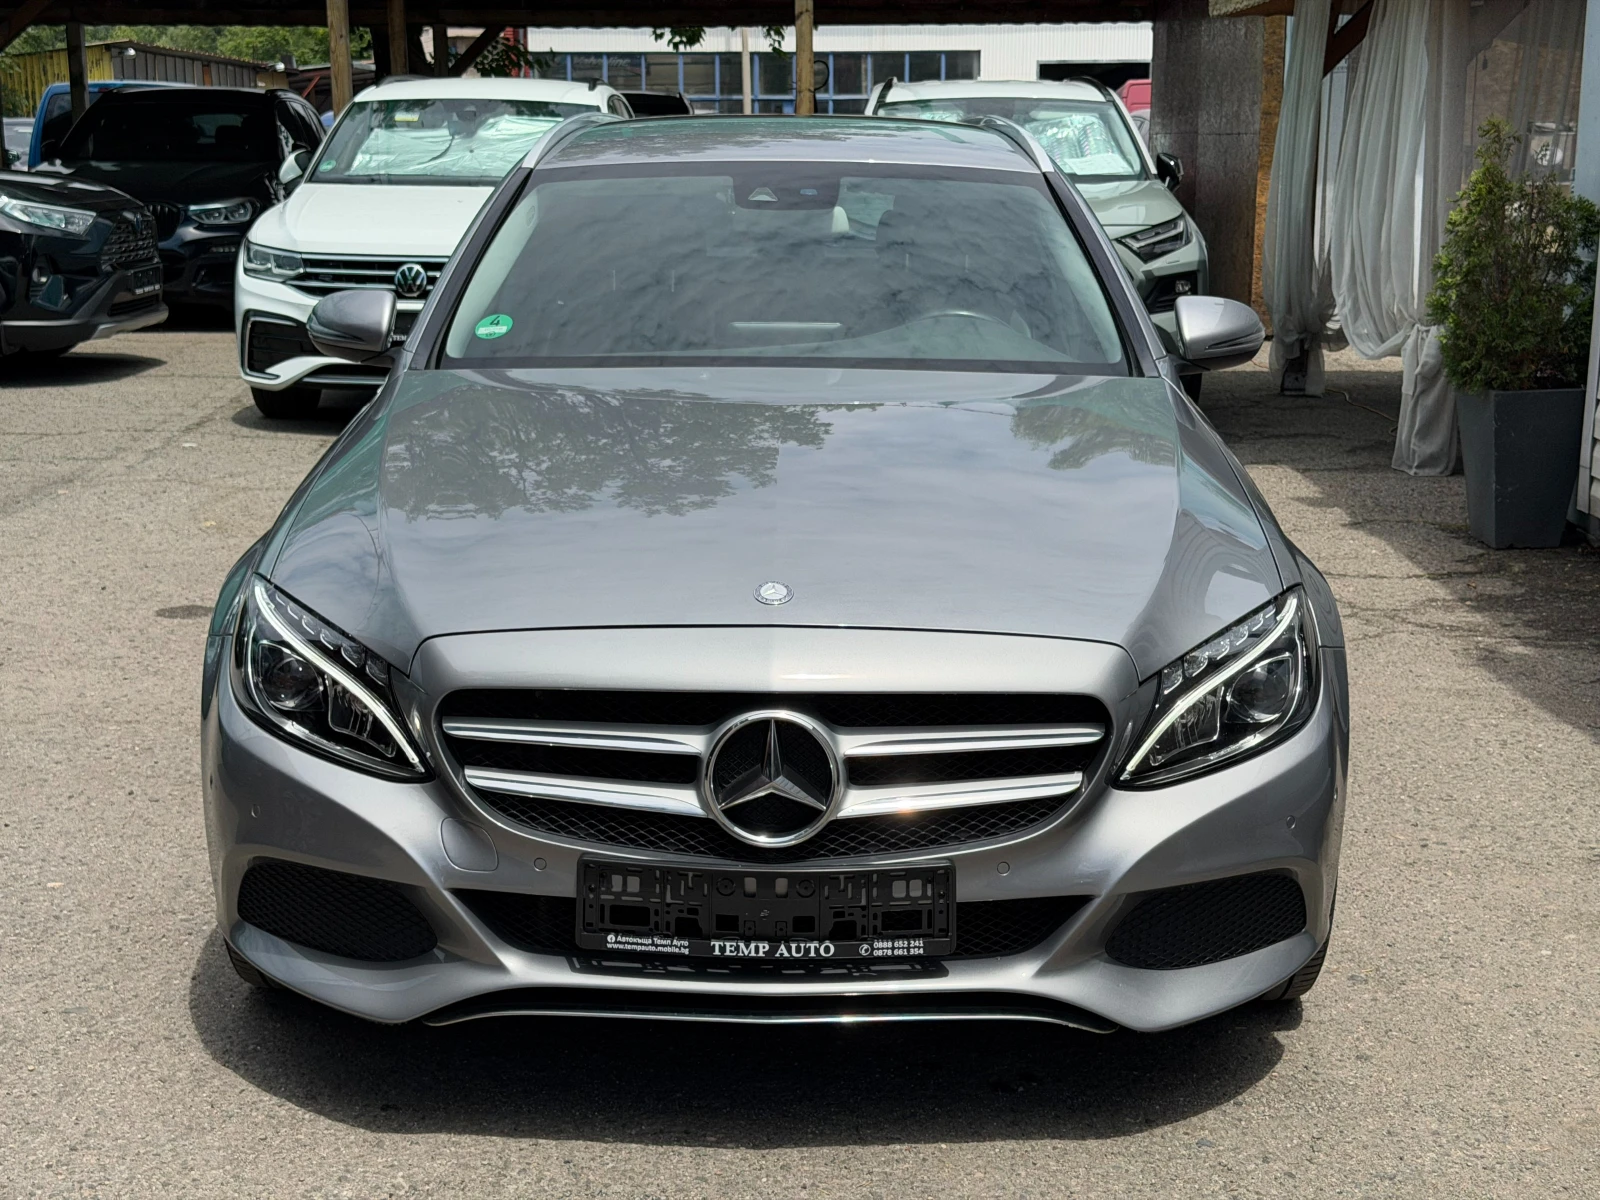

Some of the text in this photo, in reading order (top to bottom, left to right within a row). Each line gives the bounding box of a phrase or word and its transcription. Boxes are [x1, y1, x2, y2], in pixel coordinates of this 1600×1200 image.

[489, 315, 500, 326] 4
[616, 935, 689, 947] Автокъща Темп Ауто
[873, 941, 892, 949] 0888
[606, 943, 690, 954] www.tempauto.mobile.bg
[710, 941, 835, 957] TEMP AUTO
